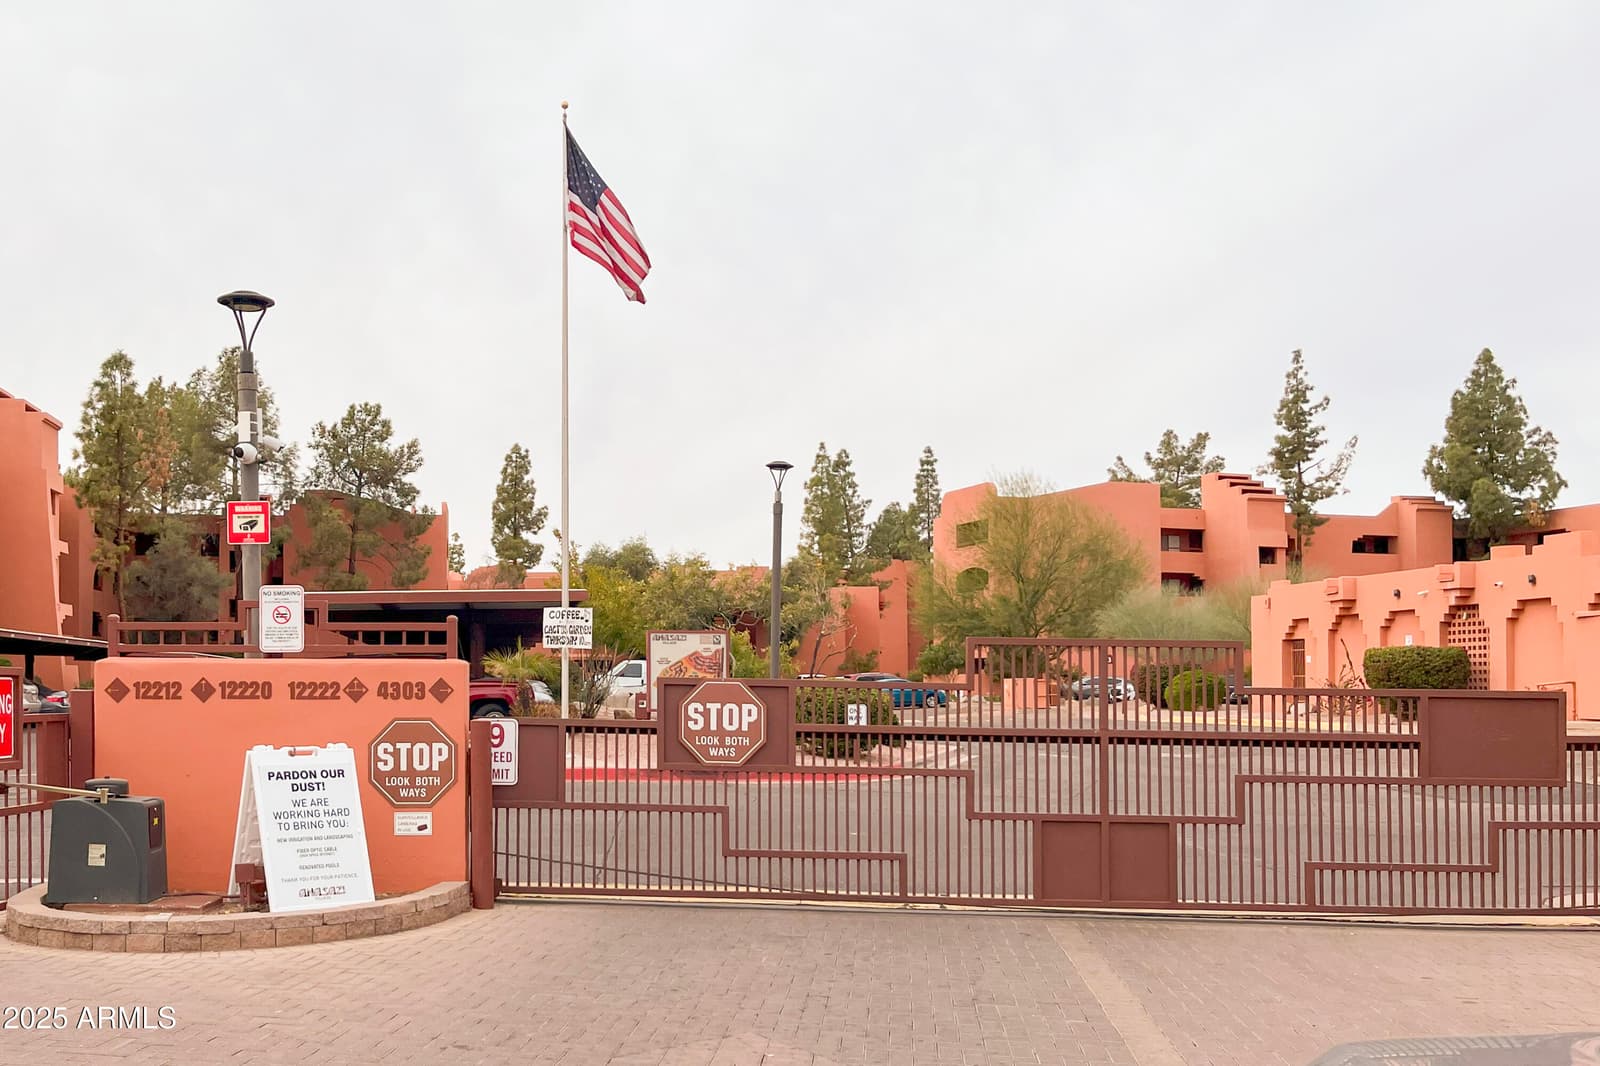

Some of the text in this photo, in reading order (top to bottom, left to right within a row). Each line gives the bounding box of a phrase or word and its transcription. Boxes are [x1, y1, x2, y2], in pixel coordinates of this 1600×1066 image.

[133, 681, 425, 700] 12212 12220 12222 4303
[687, 702, 758, 732] STOP
[491, 723, 505, 748] 9
[695, 736, 750, 746] LOOK BOTH
[377, 742, 449, 771] STOP
[492, 752, 512, 762] EED
[709, 747, 736, 757] WAYS
[267, 769, 345, 781] PARDON OUR
[492, 769, 510, 780] MIT
[291, 782, 326, 792] DUST!
[385, 777, 441, 786] LOOK BOTH
[399, 788, 427, 797] WAYS
[291, 798, 329, 807] WE ARE
[272, 807, 350, 820] WORKING HARD
[278, 819, 349, 831] TO BRING YOU:
